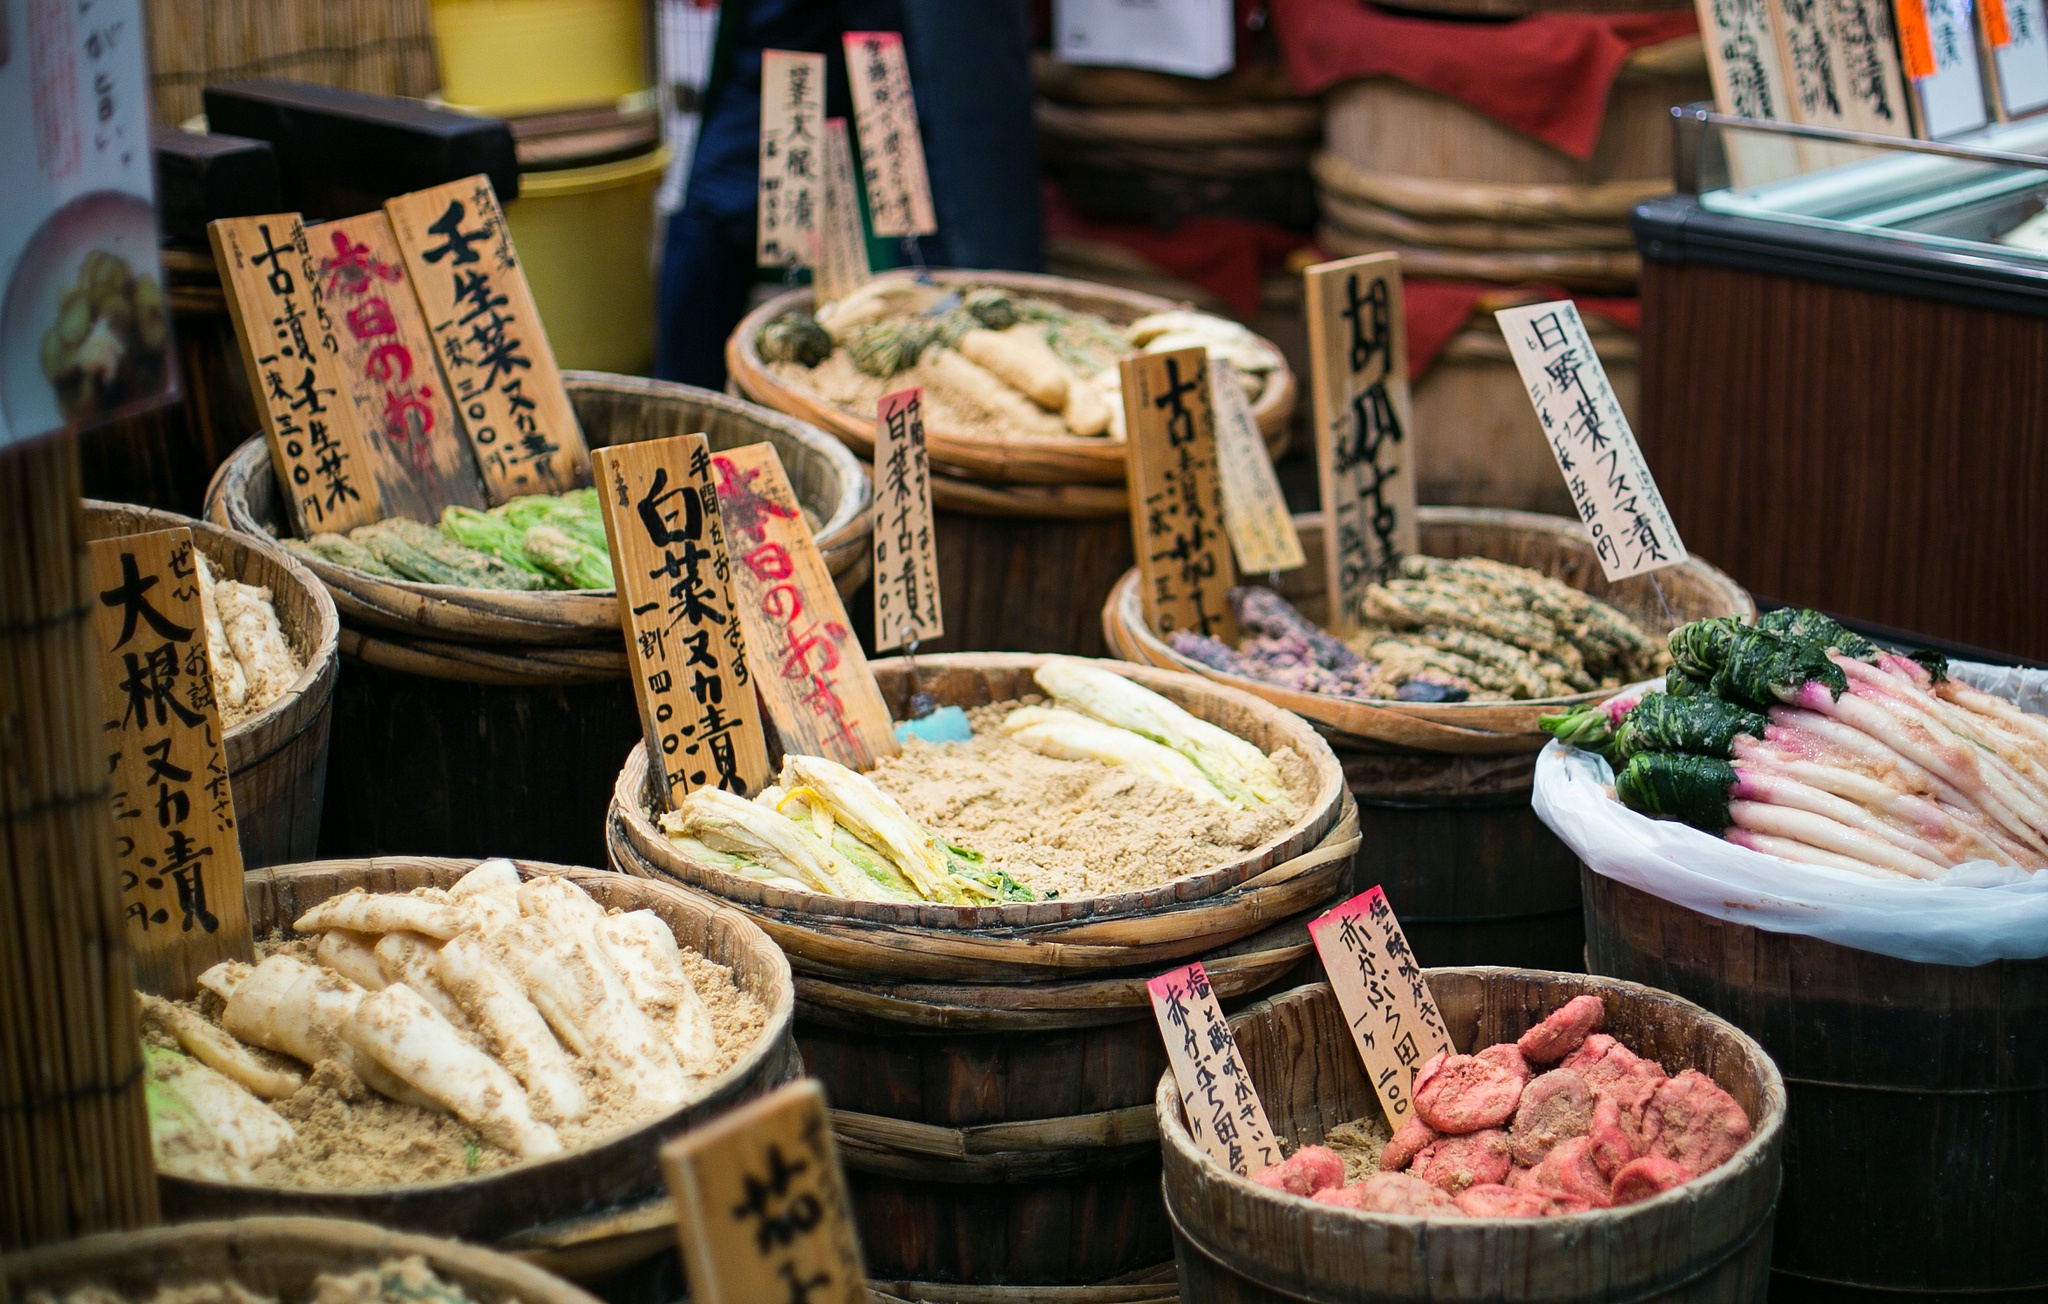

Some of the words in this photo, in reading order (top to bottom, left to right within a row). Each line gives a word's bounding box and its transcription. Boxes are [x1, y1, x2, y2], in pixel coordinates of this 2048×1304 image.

[251, 224, 360, 513] 古漬壬生菜
[1530, 312, 1668, 569] 日野菜フスマ漬
[689, 445, 749, 687] 手間をおしまず
[886, 399, 925, 628] 白菜古漬
[633, 601, 690, 795] 一割四〇〇円
[1186, 967, 1273, 1167] 塩と酸味がきいて
